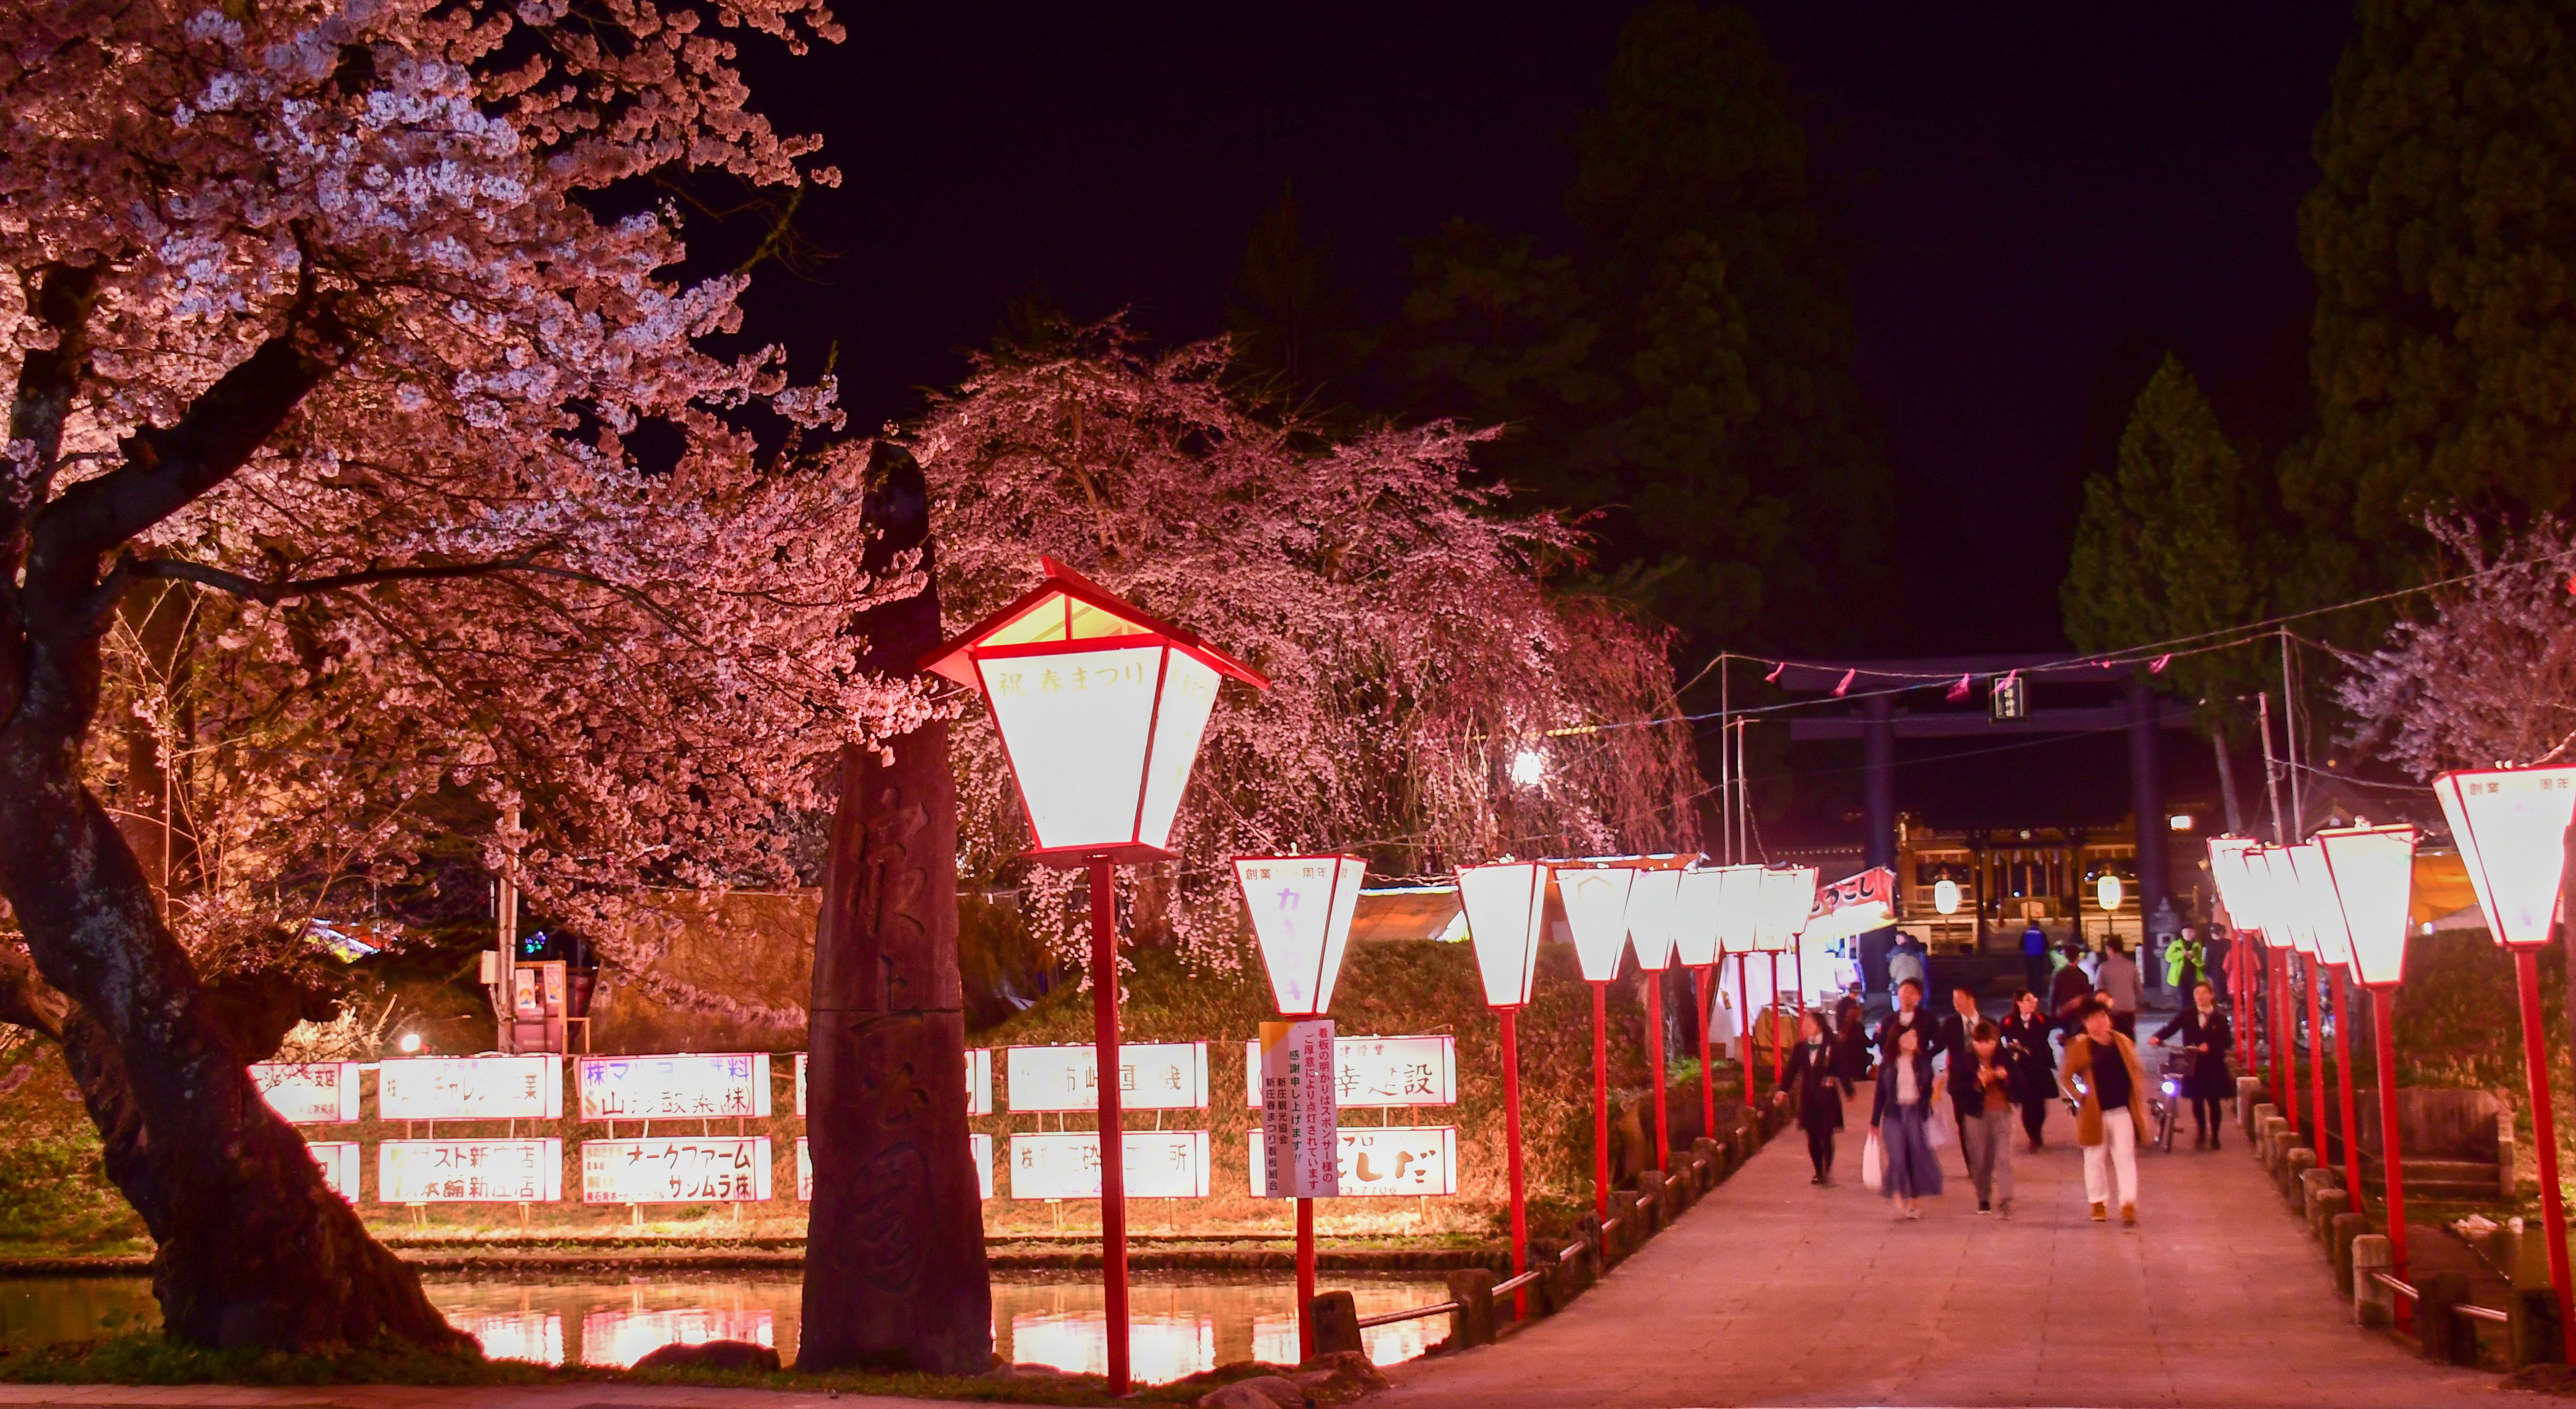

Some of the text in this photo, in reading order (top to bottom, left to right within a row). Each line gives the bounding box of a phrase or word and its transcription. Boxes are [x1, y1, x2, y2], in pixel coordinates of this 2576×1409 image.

[1265, 1078, 1278, 1191] 新庄春まつり看板組合
[1277, 1077, 1288, 1145] 新庄観光協会
[1304, 1034, 1319, 1191] ご厚意により点灯されています
[1318, 1028, 1333, 1183] 看板の明かりはスポンサー様の
[627, 1143, 751, 1170] オークファーム
[1337, 1149, 1436, 1184] しだ
